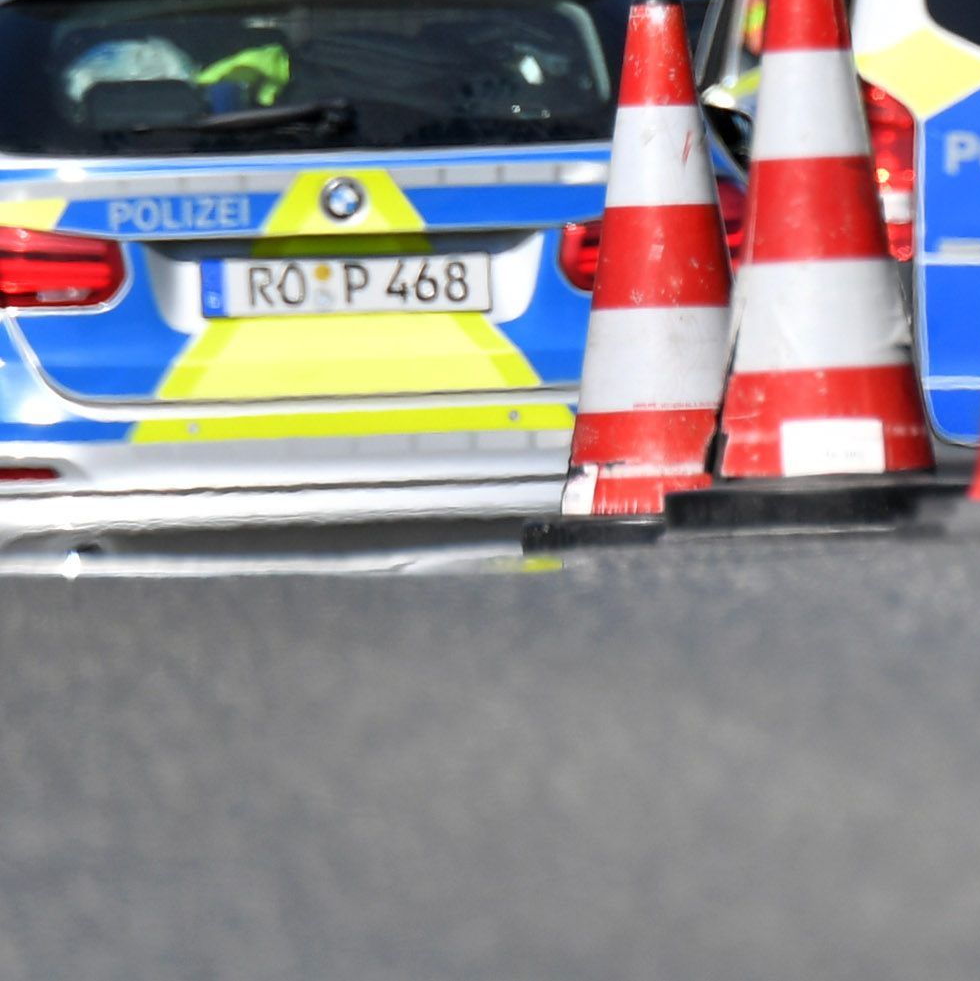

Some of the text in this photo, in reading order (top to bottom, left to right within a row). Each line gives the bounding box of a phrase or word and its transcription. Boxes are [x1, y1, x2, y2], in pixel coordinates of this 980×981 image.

[107, 195, 250, 233] POLIZEI
[343, 264, 370, 304] P
[386, 259, 468, 304] 468
